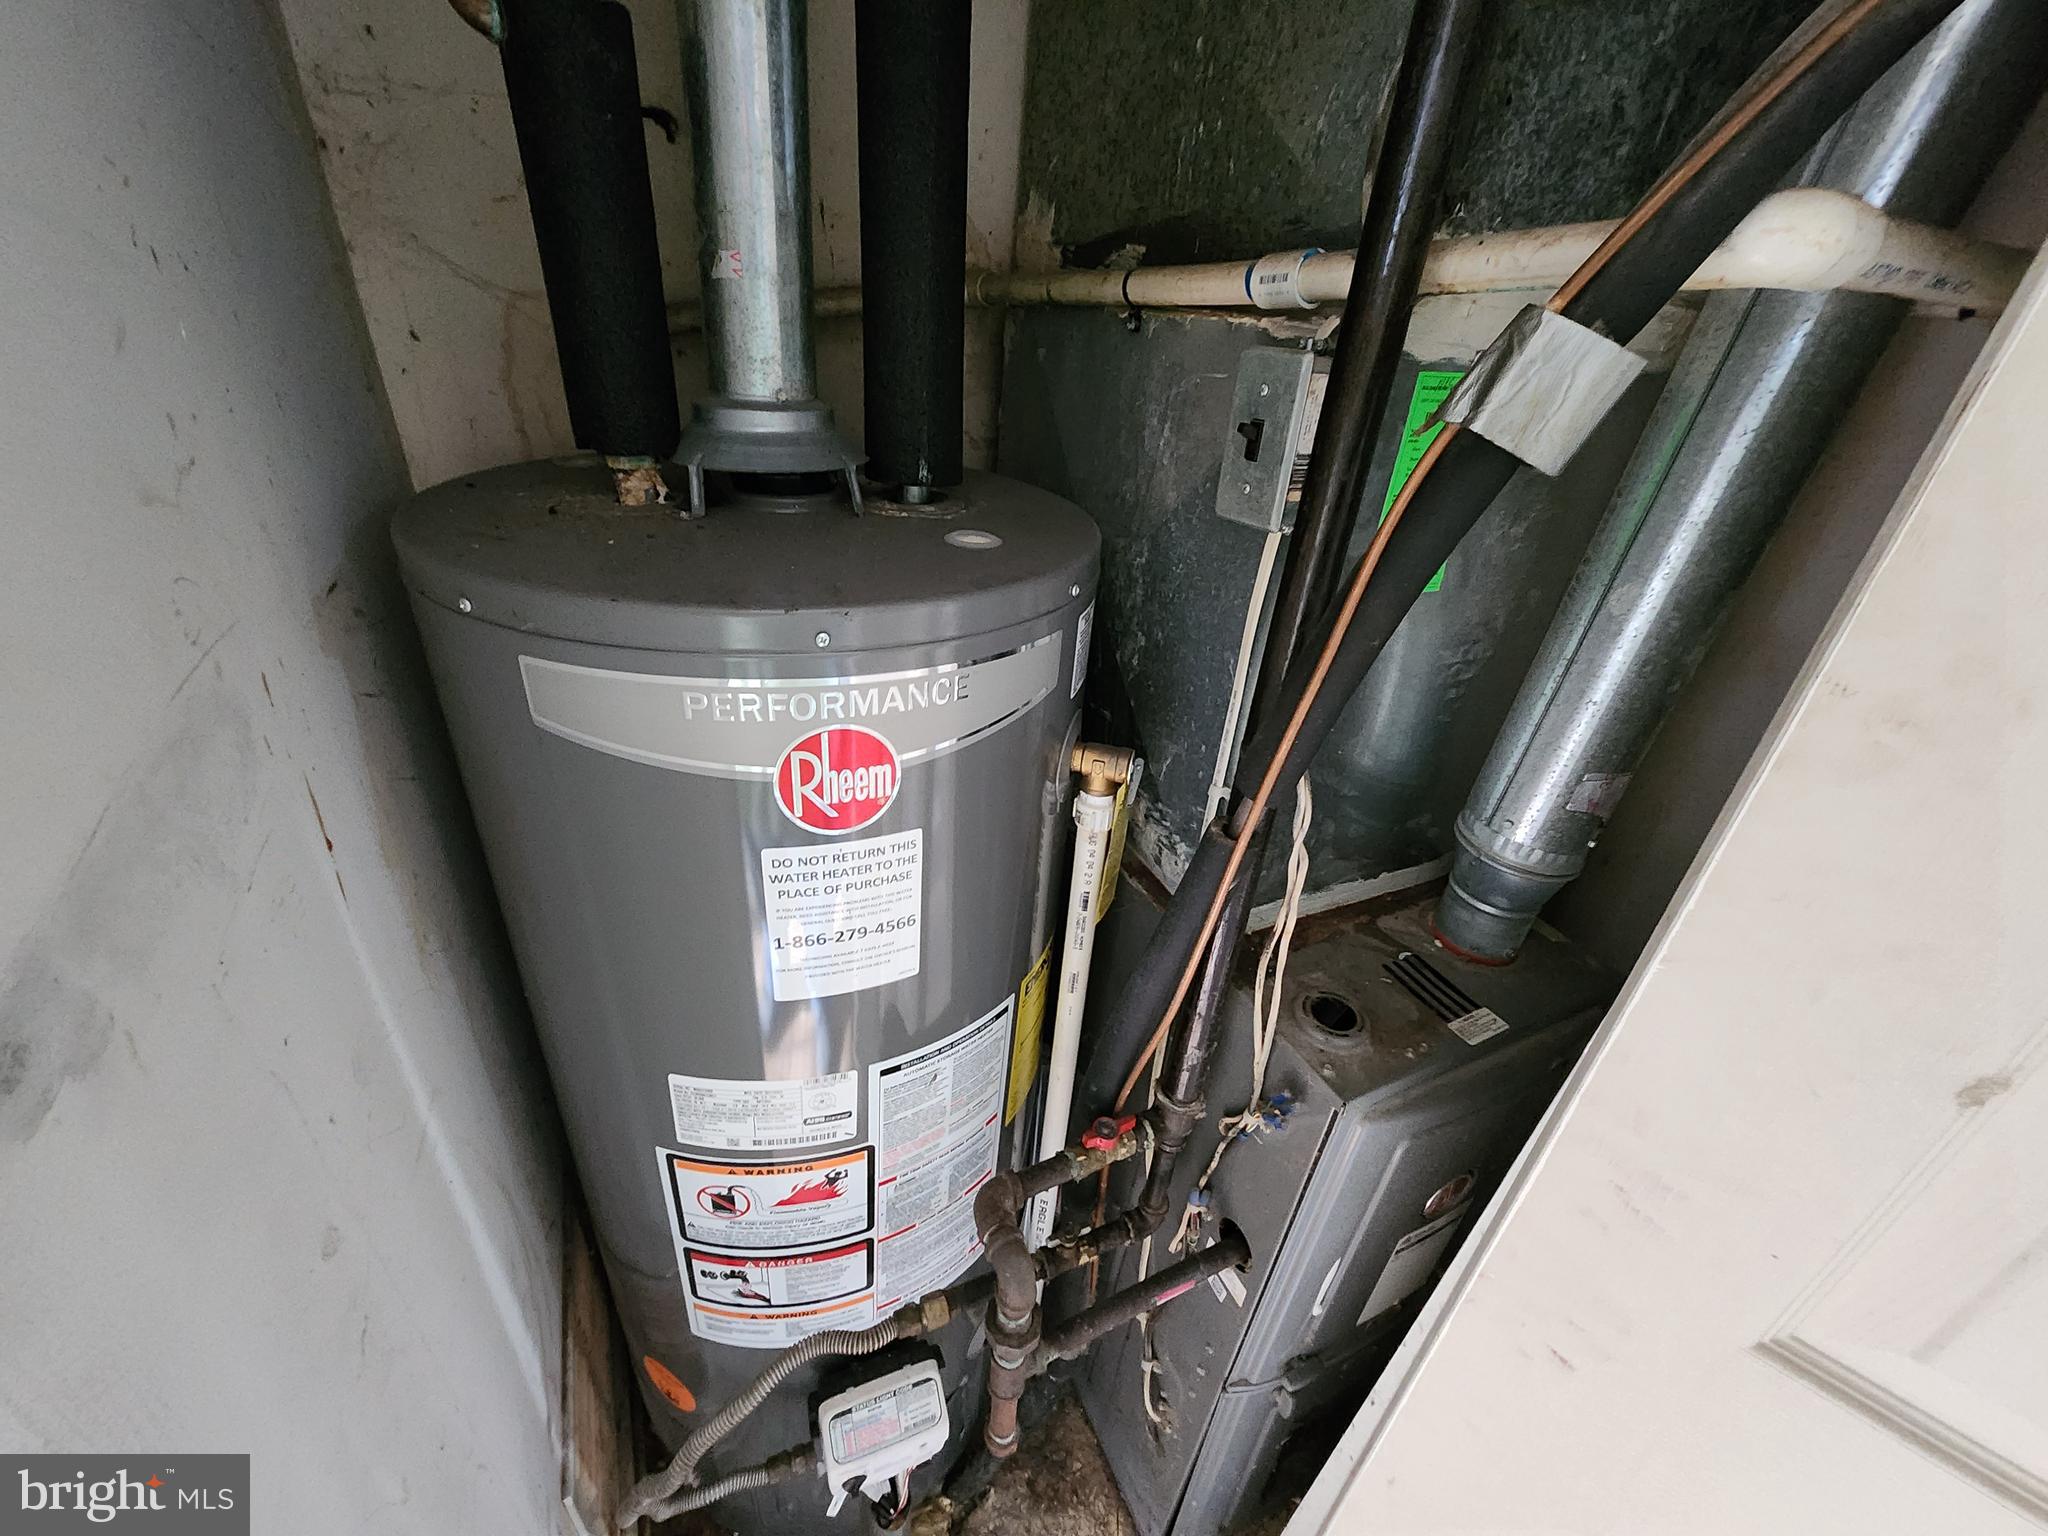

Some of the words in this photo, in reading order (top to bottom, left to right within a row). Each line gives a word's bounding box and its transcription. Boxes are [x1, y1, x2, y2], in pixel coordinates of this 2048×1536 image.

[682, 673, 969, 722] PERFORMANCE
[790, 732, 892, 818] Rheem
[768, 871, 819, 884] WATER
[822, 864, 873, 880] HEATER
[875, 860, 893, 871] TO
[895, 854, 918, 868] THE
[771, 858, 793, 869] DO
[798, 855, 828, 867] NOT
[832, 846, 886, 863] RETURN
[889, 839, 917, 854] THIS
[778, 887, 820, 899] PLACE
[824, 884, 842, 895] OF
[845, 870, 913, 892] PURCHASE
[773, 914, 917, 950] 1-866-279-4566
[744, 1165, 813, 1175] WARNING
[1036, 1199, 1049, 1234] EAGLE
[759, 1257, 813, 1268] DANGER
[764, 1311, 818, 1320] WARNING
